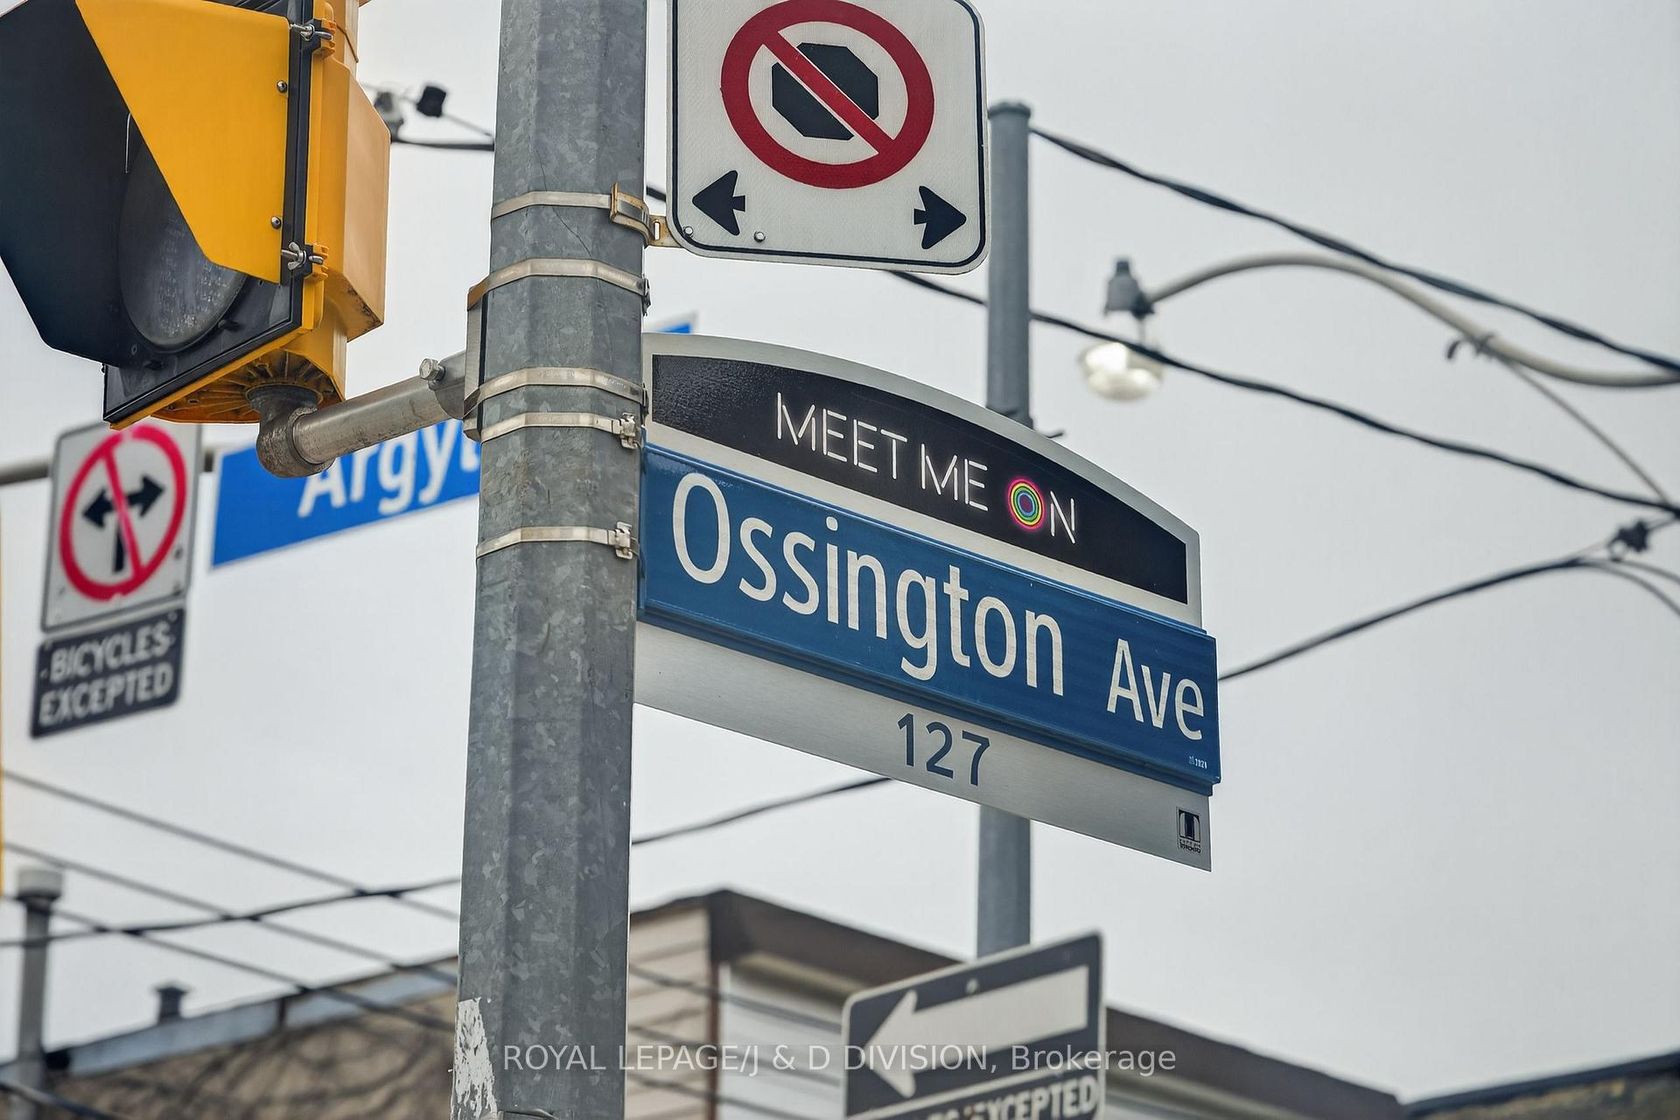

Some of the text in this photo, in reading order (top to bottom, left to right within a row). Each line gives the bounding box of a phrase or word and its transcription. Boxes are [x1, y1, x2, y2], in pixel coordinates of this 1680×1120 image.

[777, 391, 1076, 544] MEET ME ON
[671, 472, 1205, 740] Ossington Ave
[50, 620, 171, 683] BICYCLES
[38, 662, 174, 727] EXCEPTED
[897, 712, 991, 786] 127
